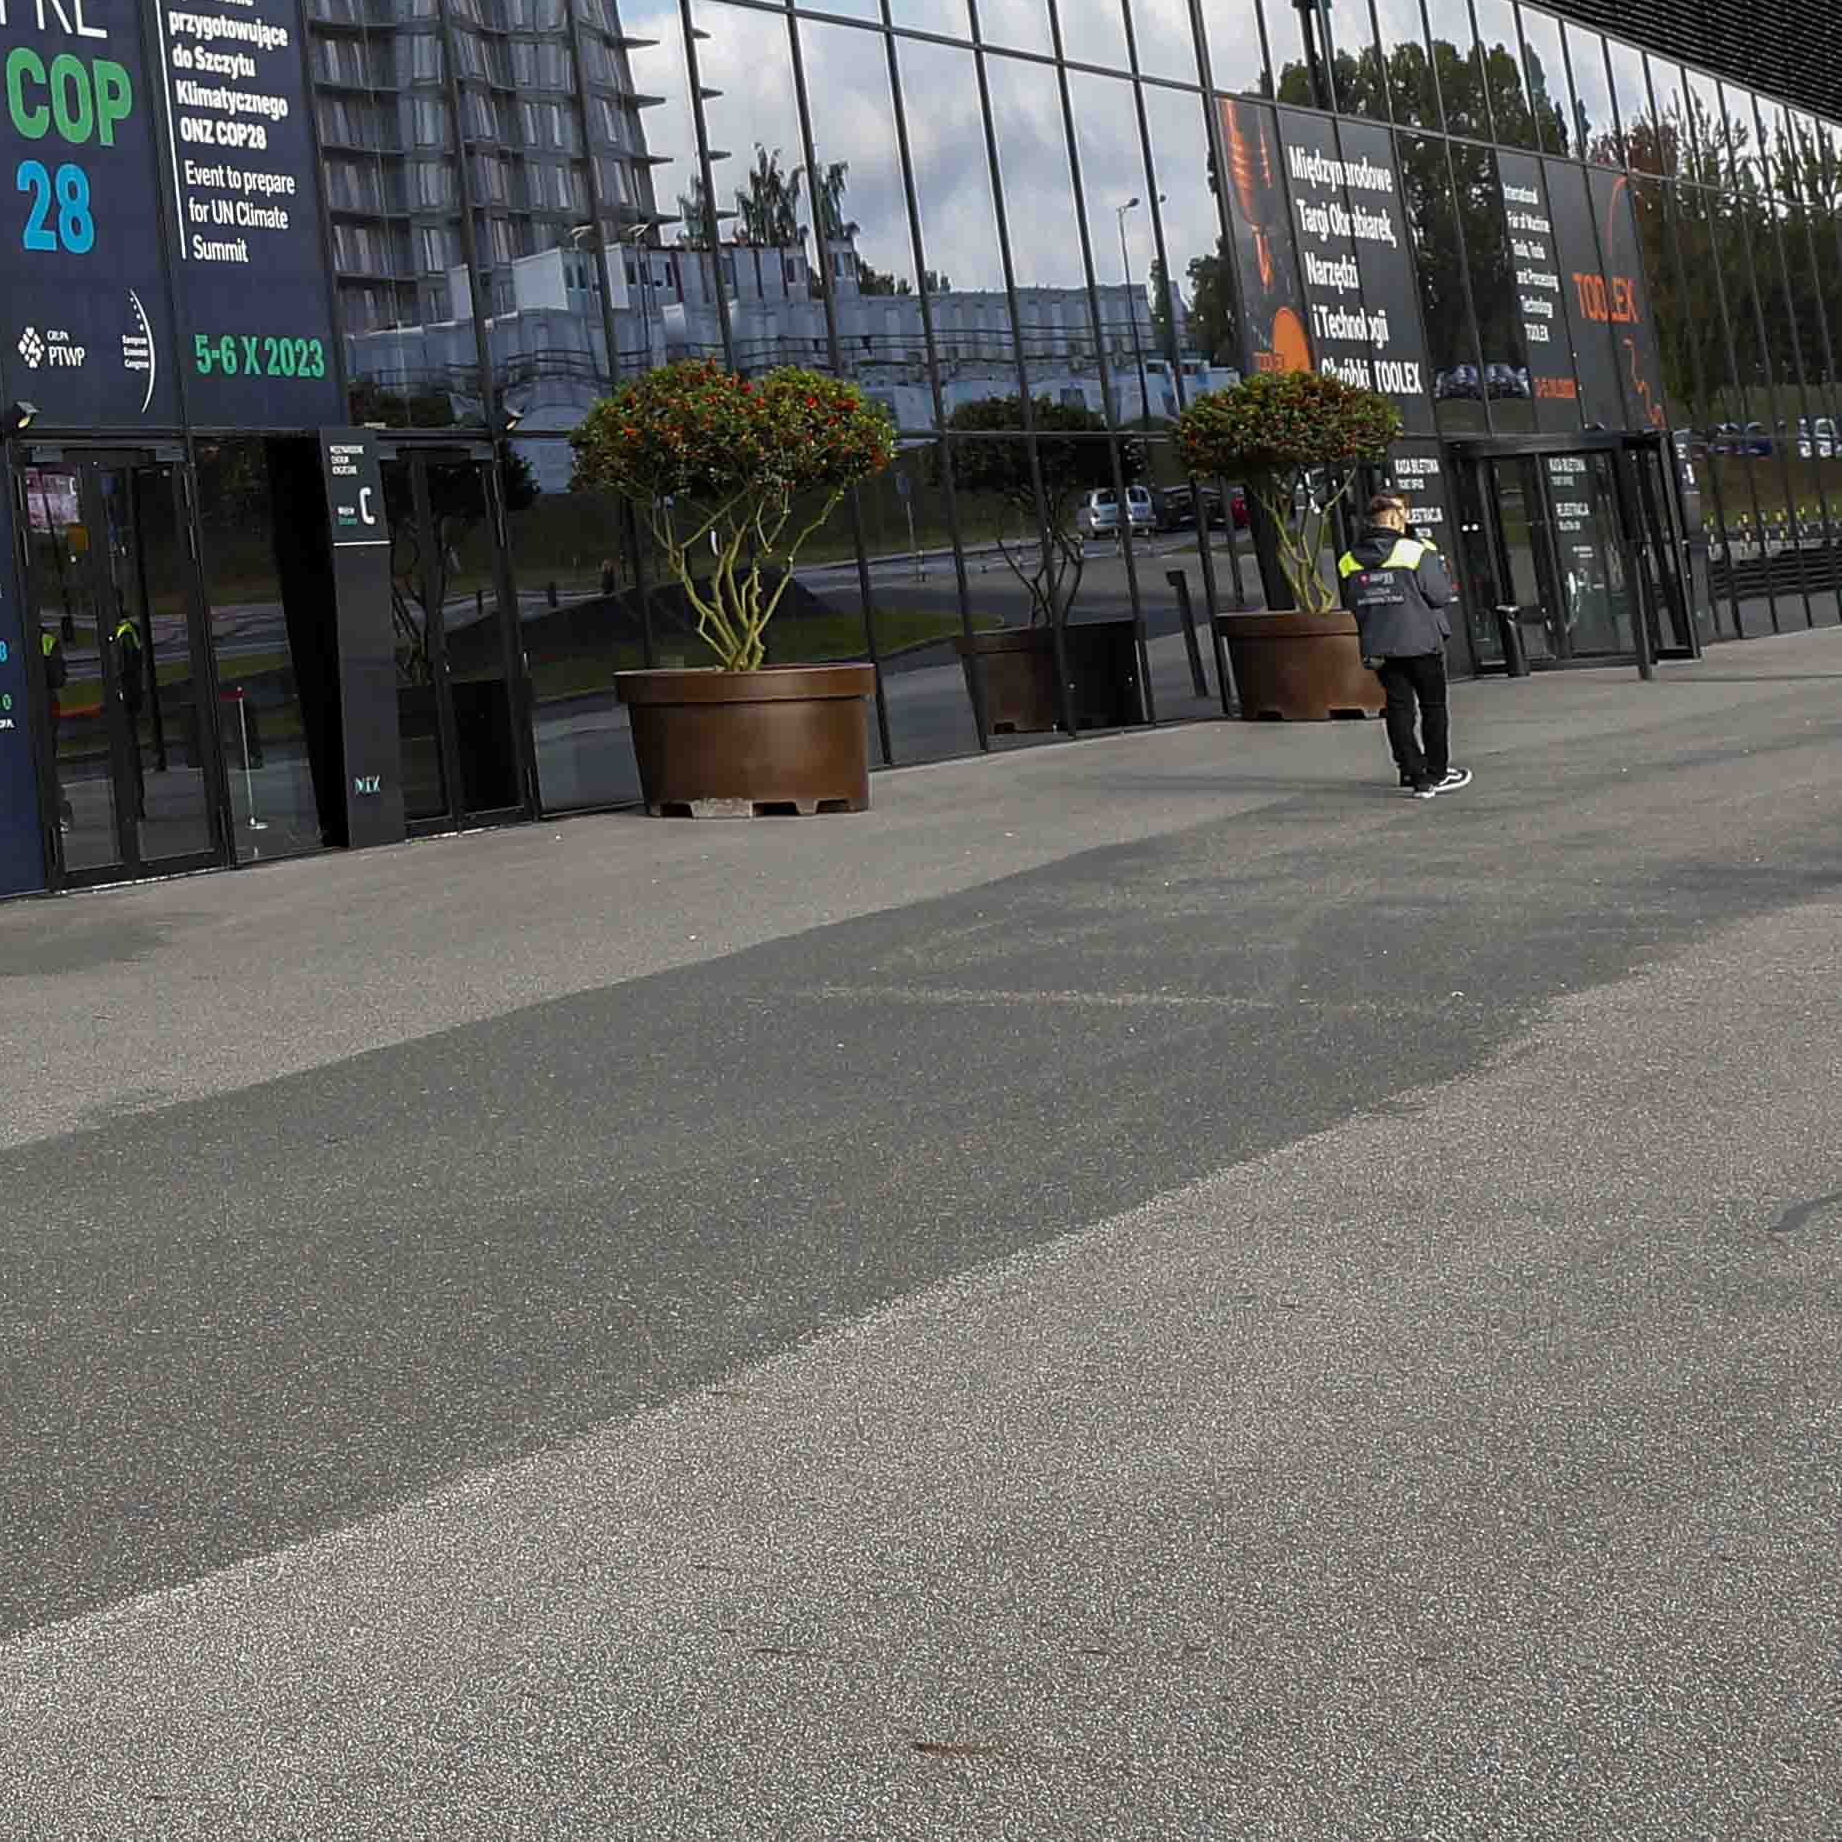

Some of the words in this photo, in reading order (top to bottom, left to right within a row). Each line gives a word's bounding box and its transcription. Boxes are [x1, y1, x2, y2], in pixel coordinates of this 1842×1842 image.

[169, 11, 288, 51] przygotowujące
[172, 43, 192, 68] do
[194, 45, 255, 80] Szczytu
[5, 47, 133, 147] COP
[175, 79, 288, 121] Klimatycznego
[180, 117, 215, 143] ONZ
[216, 120, 267, 150] COP28
[184, 159, 225, 189] Event
[227, 164, 242, 190] to
[244, 170, 296, 197] prepare
[15, 160, 95, 255] 28
[189, 196, 209, 223] for
[212, 199, 234, 225] UN
[237, 201, 289, 229] Climate
[1296, 198, 1329, 242] Targi
[192, 234, 249, 263] Summit
[1304, 252, 1360, 294] Narzędzi
[1572, 272, 1644, 323] TOOEX
[48, 346, 85, 367] PTWP
[194, 334, 237, 374] 5-6
[241, 336, 262, 375] X
[264, 336, 325, 377] 2023
[1373, 360, 1423, 394] TOOLEX
[359, 486, 376, 525] C
